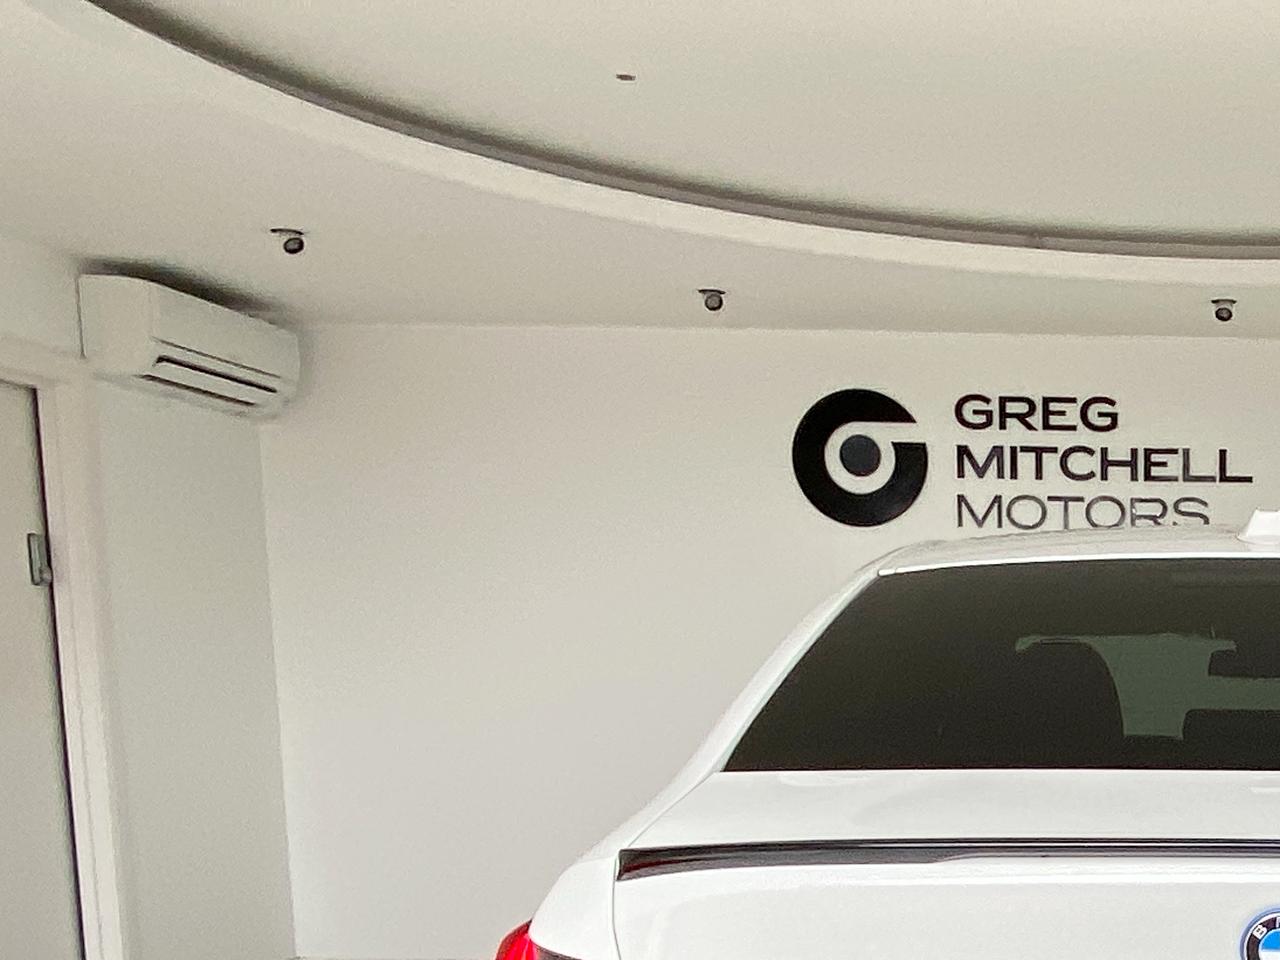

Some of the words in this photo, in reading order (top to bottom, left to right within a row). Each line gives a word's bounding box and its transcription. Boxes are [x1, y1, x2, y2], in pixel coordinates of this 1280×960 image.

[954, 394, 1119, 432] GREG
[956, 444, 1253, 484] MITCHELL
[957, 494, 1210, 529] MOTORS
